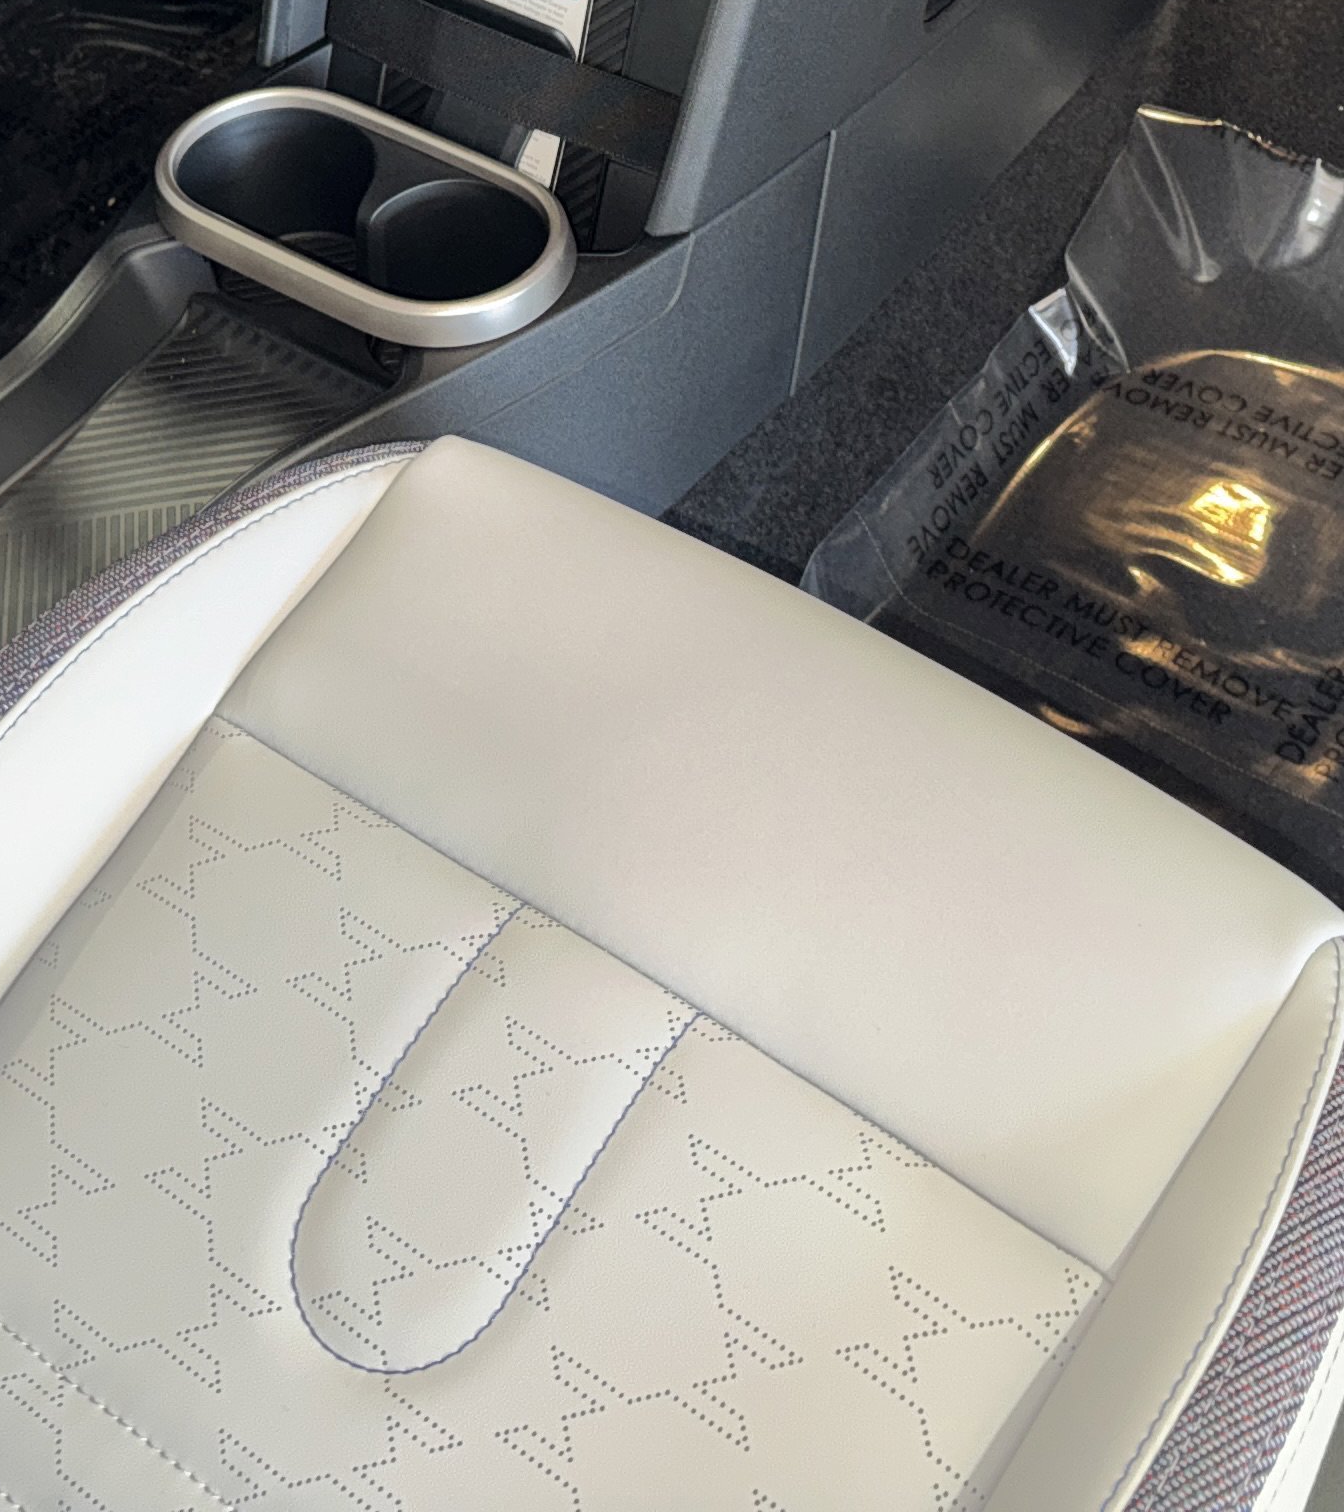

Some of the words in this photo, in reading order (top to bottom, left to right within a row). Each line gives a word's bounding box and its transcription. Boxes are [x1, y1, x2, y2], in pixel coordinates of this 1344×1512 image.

[1136, 368, 1247, 416] COVER
[931, 400, 996, 488] COVER
[988, 406, 1042, 477] MUST
[1212, 412, 1299, 465] MUST
[907, 467, 987, 566] REMOVE
[923, 557, 1119, 670] PROTECTIVE
[1113, 635, 1233, 728] COVER
[947, 538, 1059, 610] DEALER
[1064, 592, 1150, 652] MUST
[1153, 634, 1302, 724] REMOVE
